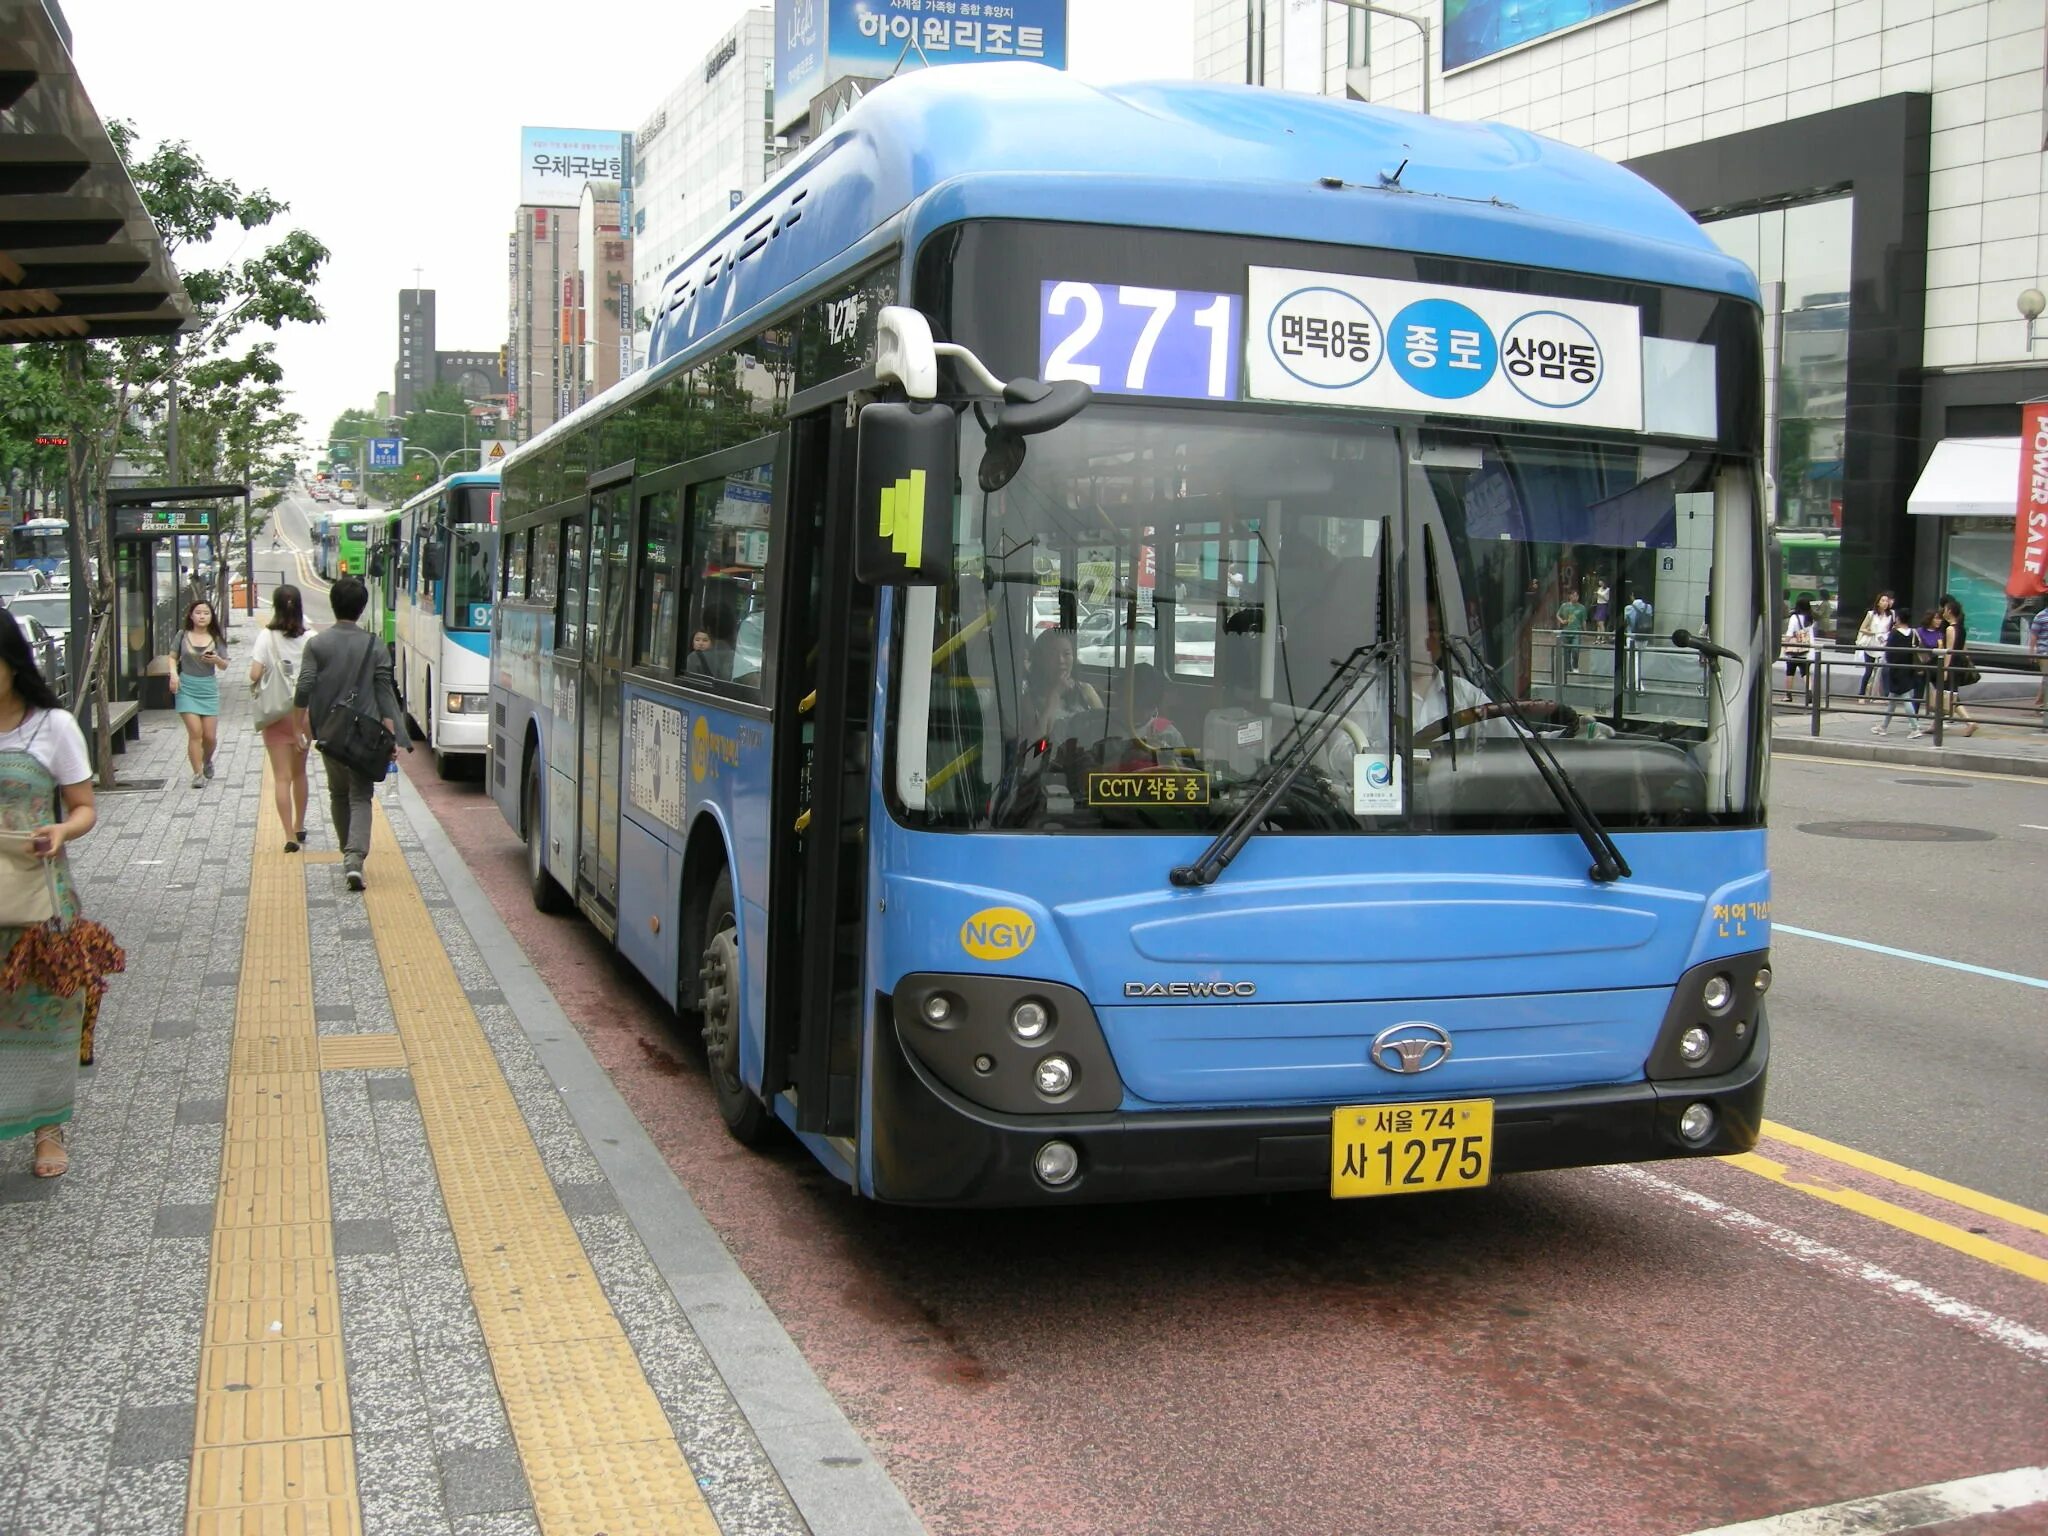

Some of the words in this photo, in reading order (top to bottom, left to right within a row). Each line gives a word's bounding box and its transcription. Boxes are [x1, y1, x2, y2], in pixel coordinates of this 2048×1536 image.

[925, 0, 956, 14] 가족형
[960, 3, 981, 16] 종합
[983, 5, 1014, 19] 휴양지
[858, 12, 1045, 58] 하이원리조트
[1044, 281, 1231, 398] 271
[1281, 314, 1370, 363] 면목8동
[1405, 324, 1482, 370] 종로
[1505, 336, 1597, 384] 상암동
[2030, 416, 2048, 505] POWER
[2024, 510, 2047, 575] SALE
[1099, 779, 1143, 797] CCTV
[1146, 777, 1179, 801] 작동
[1183, 778, 1200, 801] 중
[965, 921, 1033, 949] NGV
[1124, 981, 1257, 998] DAEWOO
[1374, 1110, 1414, 1133] 서울
[1421, 1107, 1455, 1132] 74
